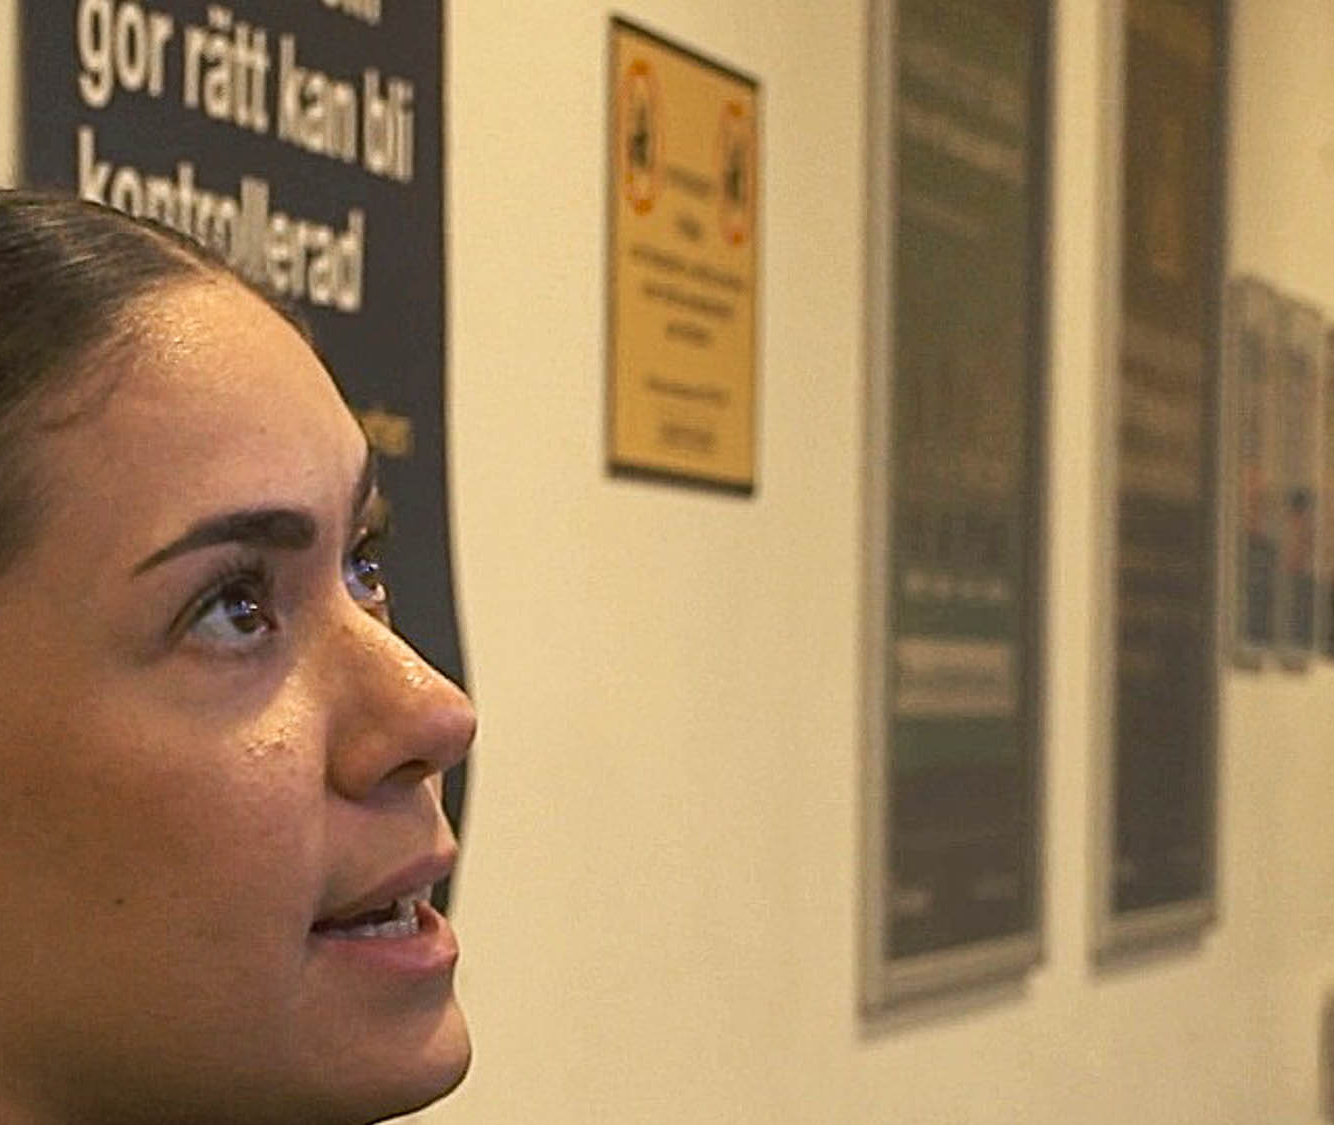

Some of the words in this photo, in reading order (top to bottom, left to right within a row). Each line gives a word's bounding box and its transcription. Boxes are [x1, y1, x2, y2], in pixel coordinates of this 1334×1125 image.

[183, 5, 271, 134] rätt
[278, 33, 357, 164] kan
[364, 68, 415, 184] bli
[78, 124, 365, 312] kontrollerad
